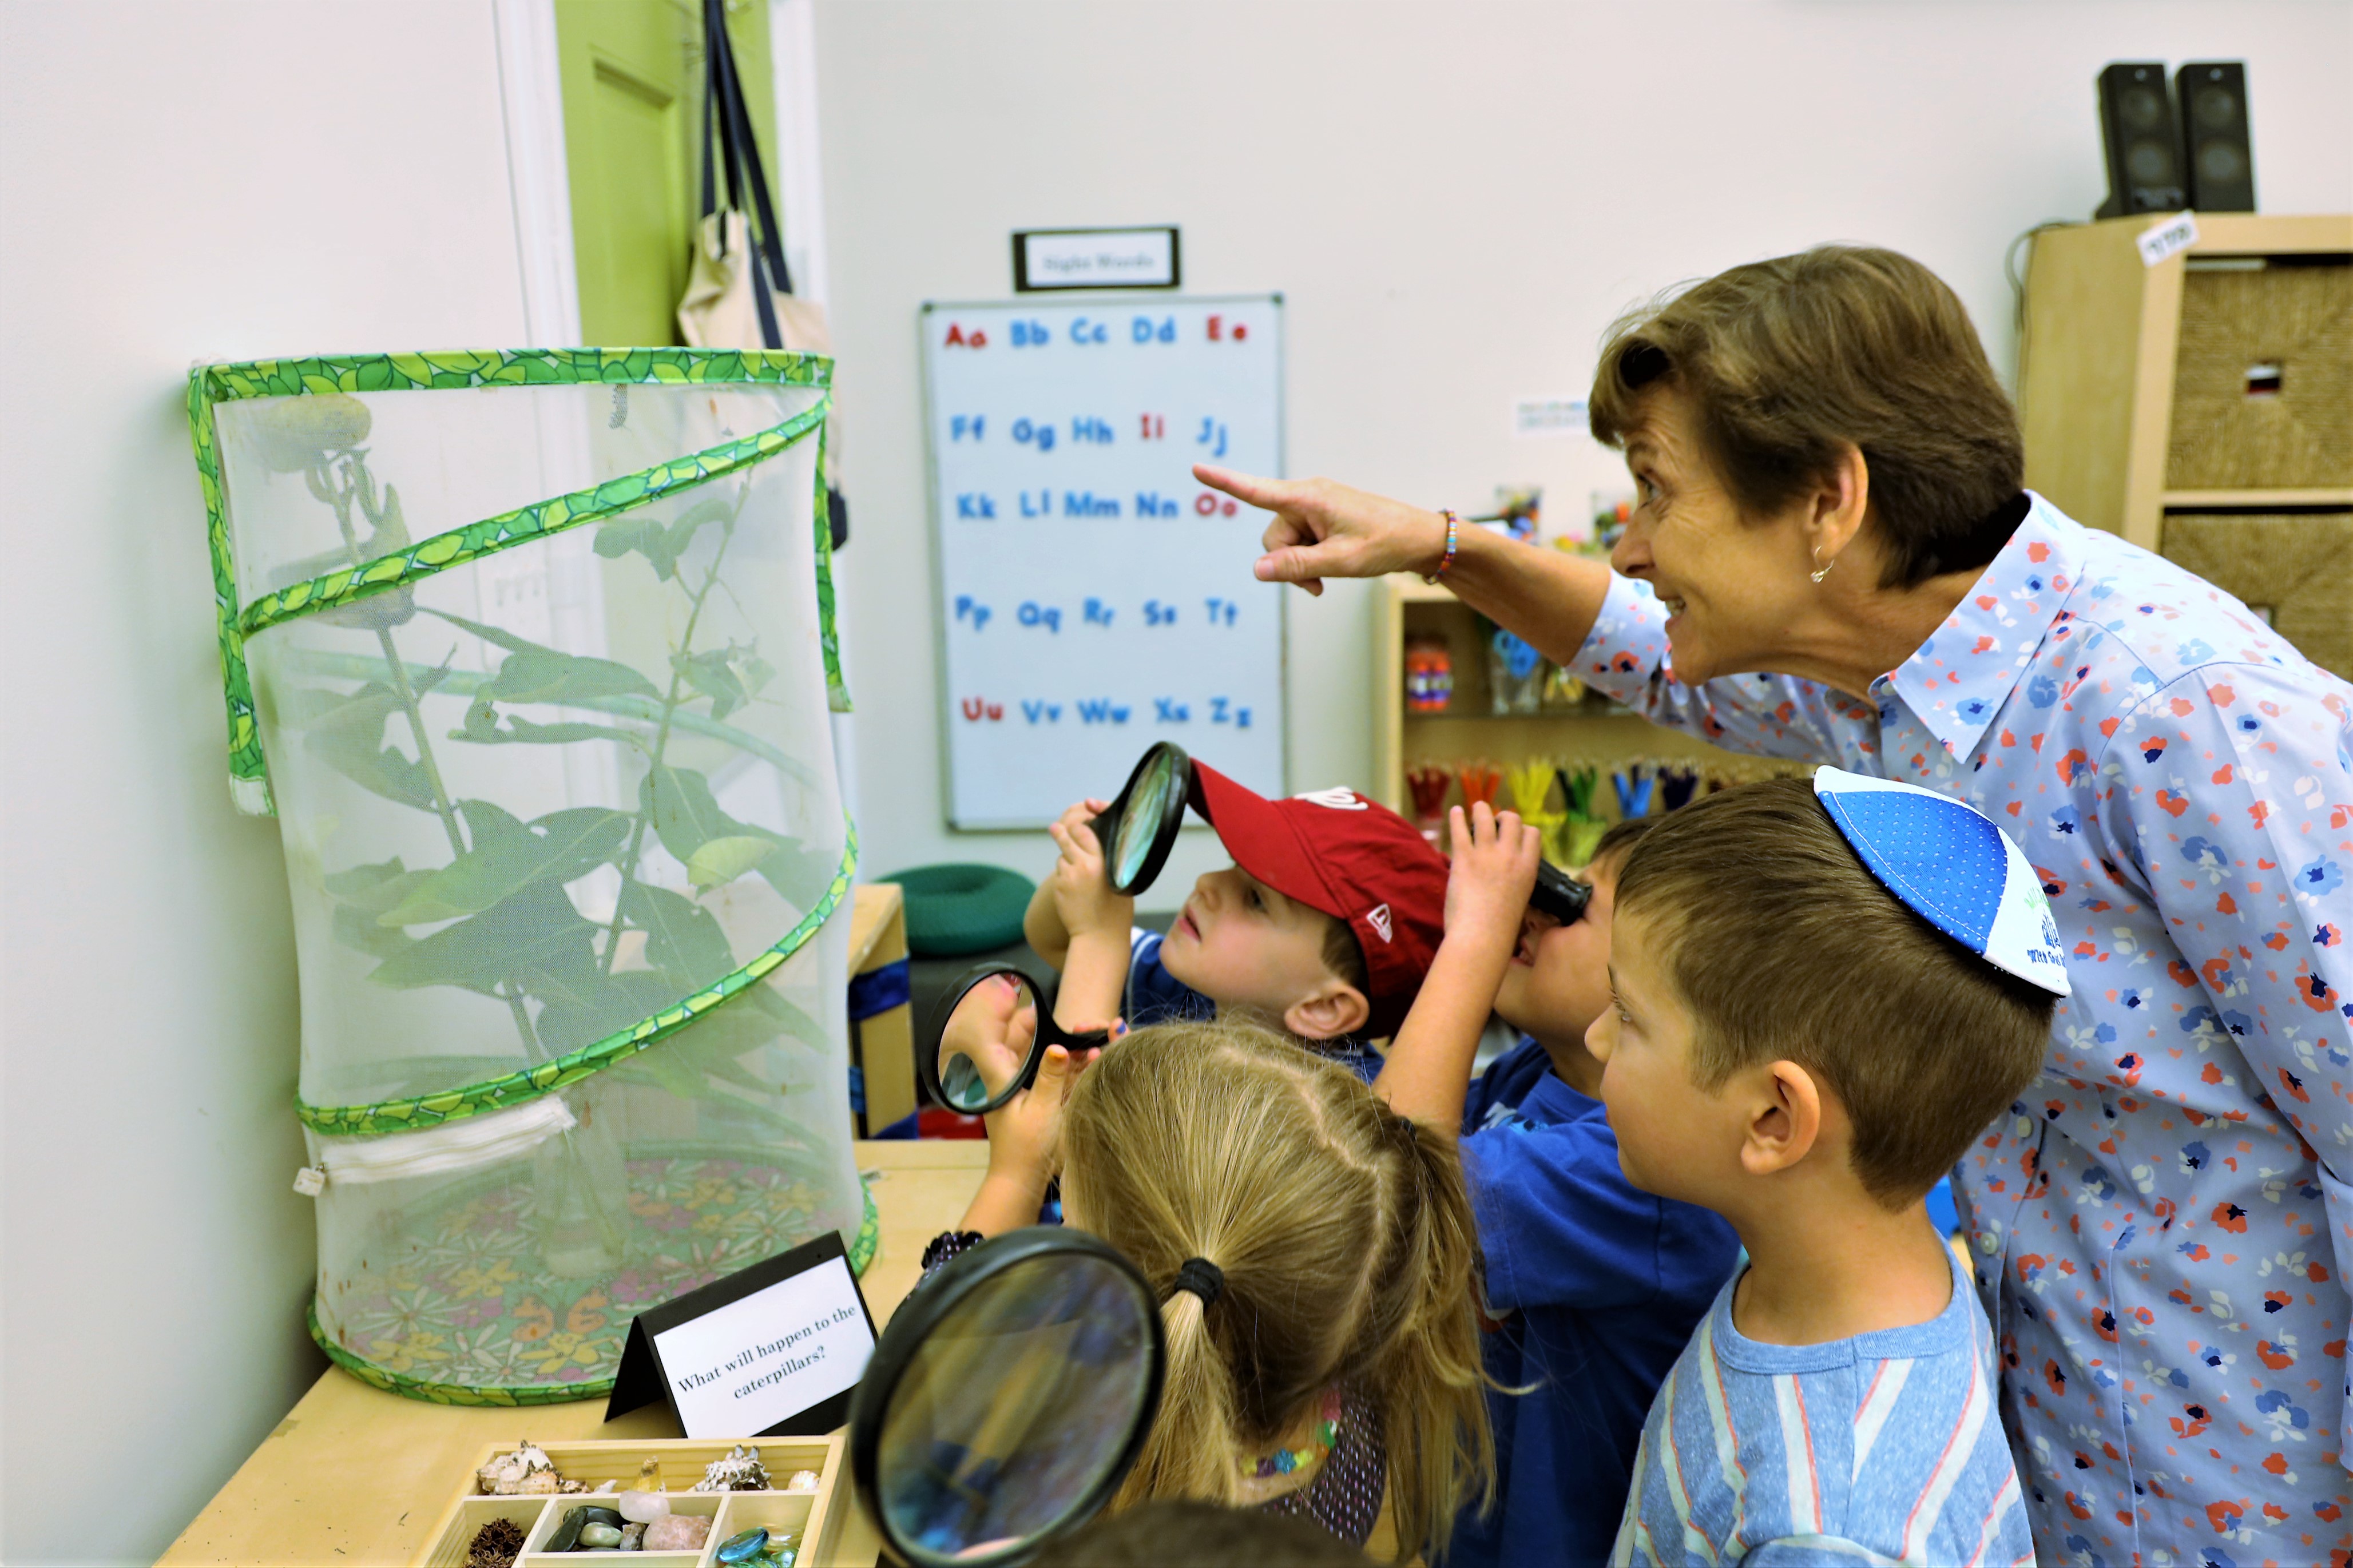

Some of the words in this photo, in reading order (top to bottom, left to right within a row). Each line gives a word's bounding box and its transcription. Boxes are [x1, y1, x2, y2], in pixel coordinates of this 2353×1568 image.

[945, 321, 988, 350] Aa
[1010, 320, 1050, 348] Bb
[1070, 318, 1107, 345] Cc
[1132, 316, 1176, 344] Dd
[950, 415, 985, 441] Ff
[1072, 416, 1114, 444] Hh
[957, 493, 996, 519] Kk
[1064, 490, 1121, 518] Mm
[1135, 491, 1180, 518] Nn
[1195, 492, 1237, 518] Oo
[955, 595, 991, 630] Pp
[1084, 597, 1114, 627] Rr
[1205, 597, 1238, 627] Tt
[962, 697, 1004, 723] Uu
[1021, 700, 1062, 725] Vv
[1077, 698, 1132, 725] Ww
[678, 1366, 722, 1394] What
[724, 1349, 754, 1373] will
[756, 1326, 812, 1358] happen
[814, 1316, 830, 1332] to
[832, 1304, 856, 1323] the
[734, 1345, 826, 1399] caterpillars?
